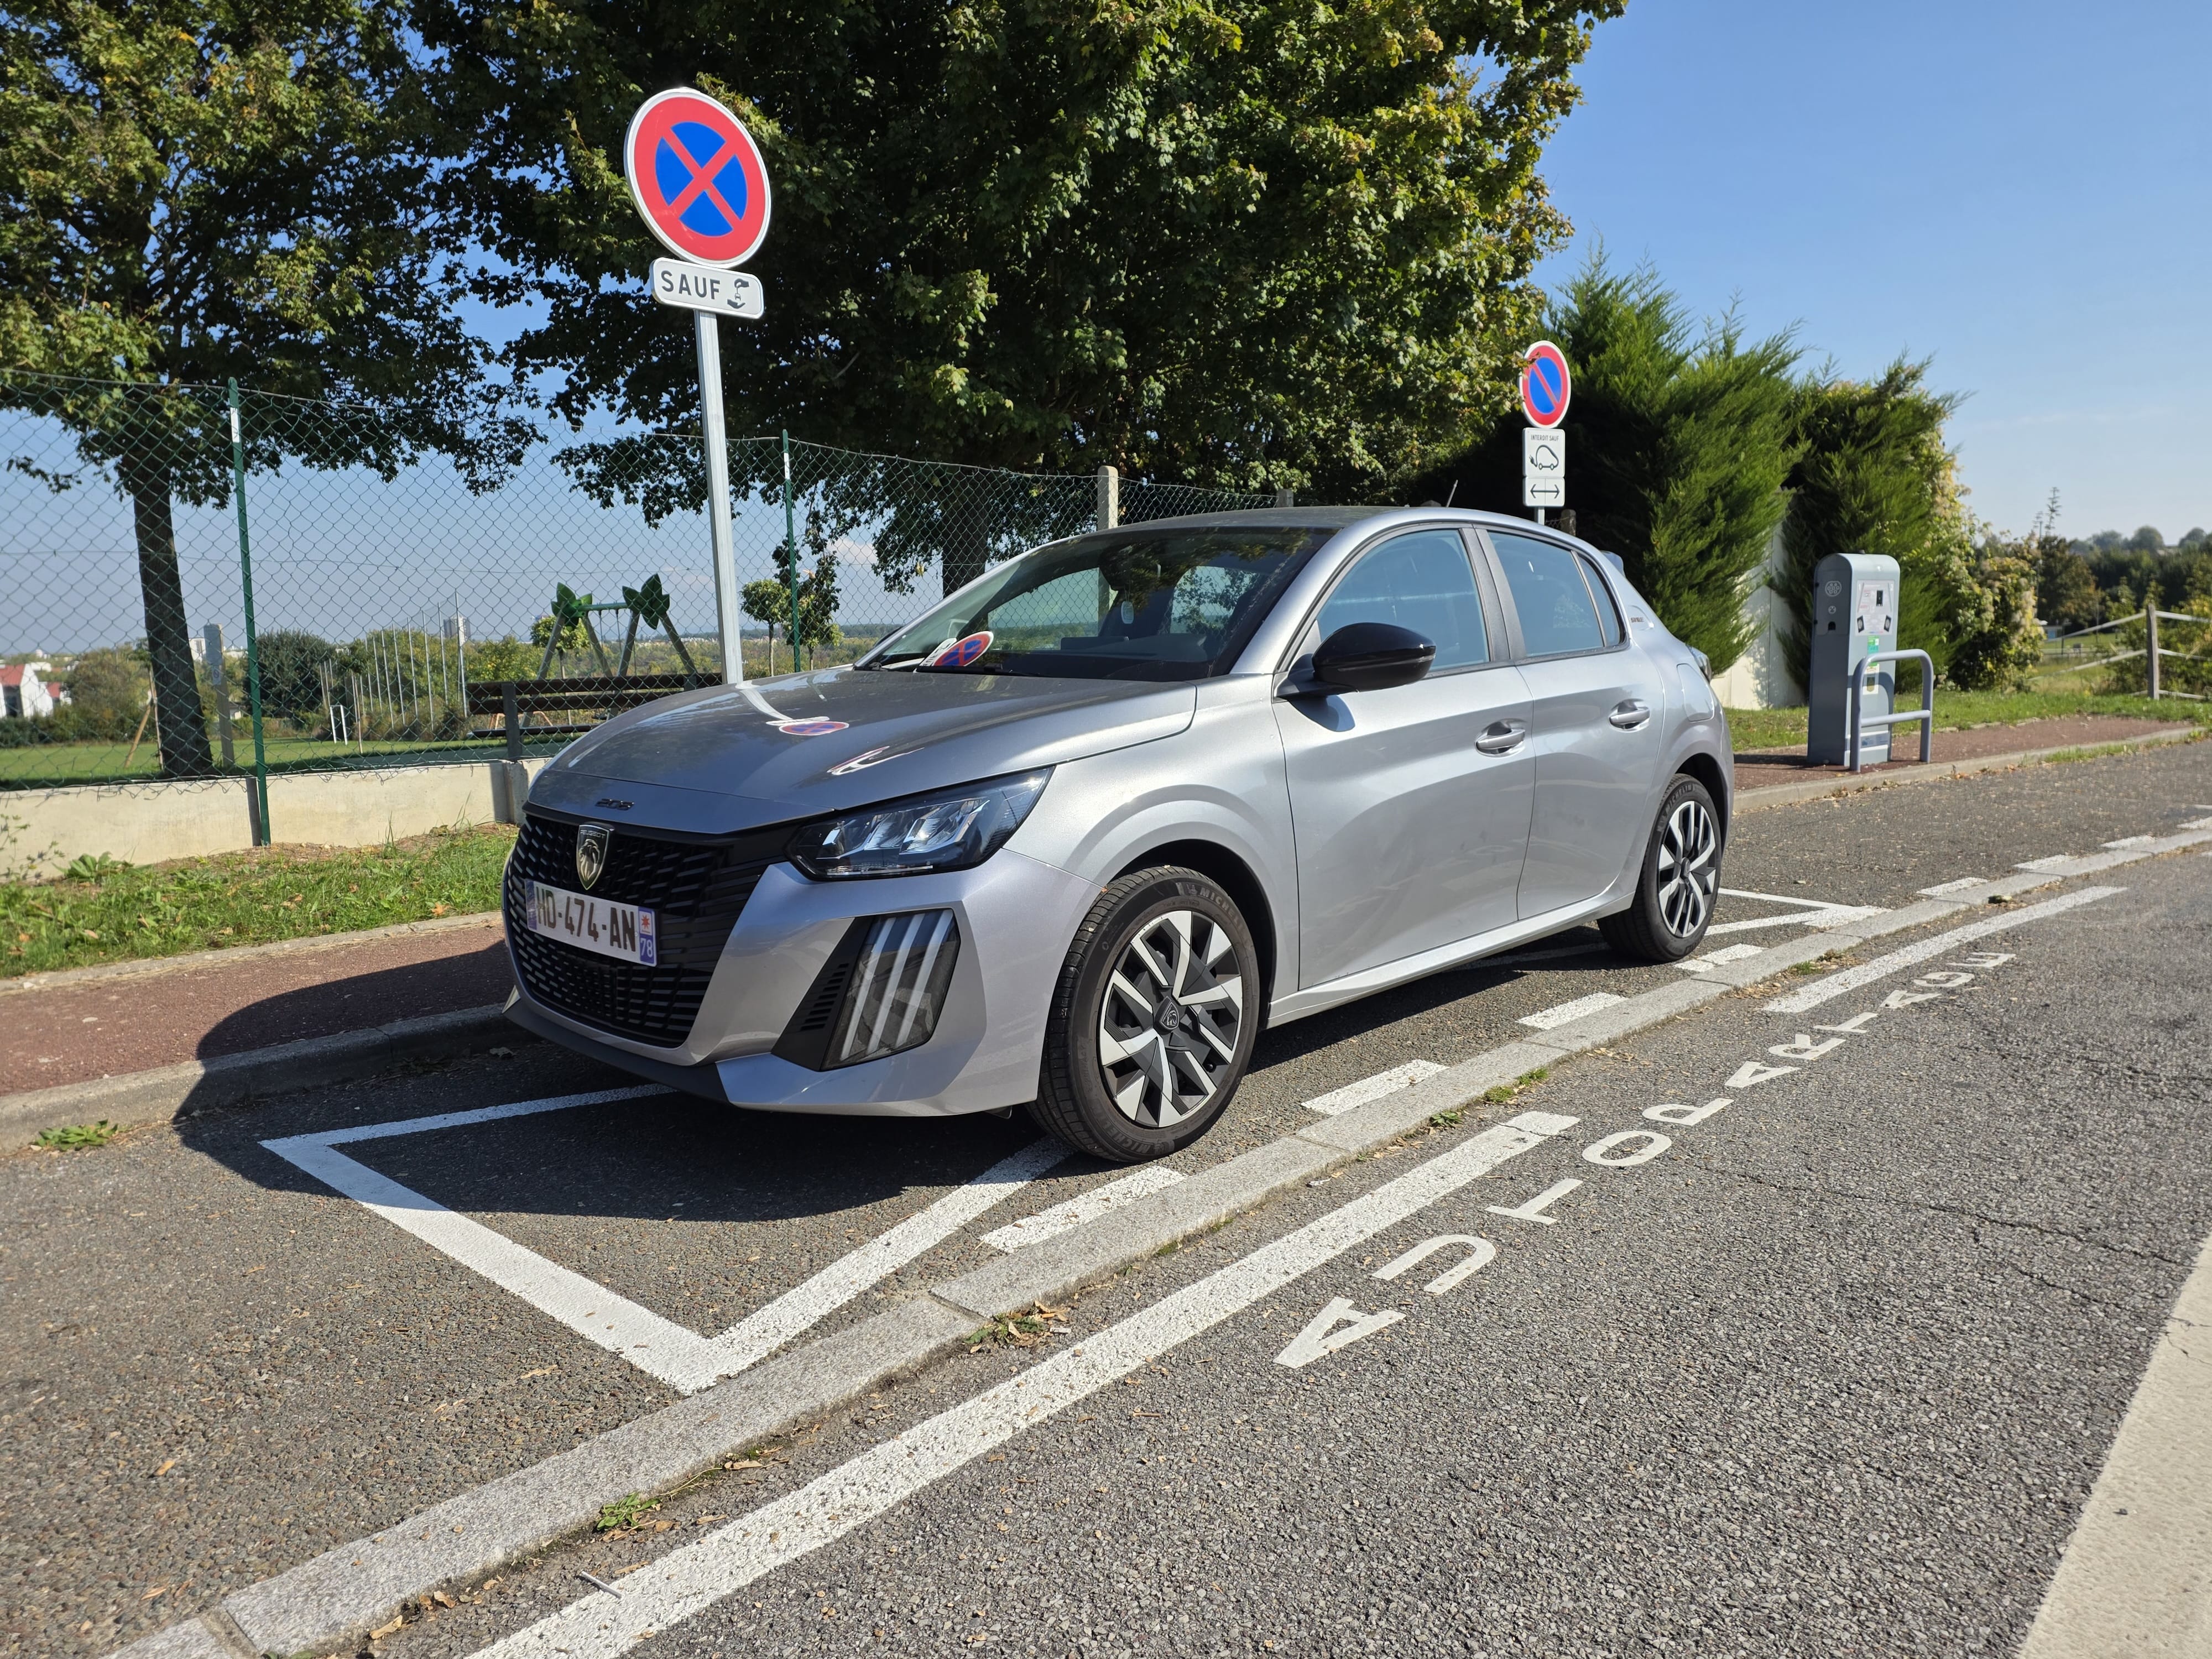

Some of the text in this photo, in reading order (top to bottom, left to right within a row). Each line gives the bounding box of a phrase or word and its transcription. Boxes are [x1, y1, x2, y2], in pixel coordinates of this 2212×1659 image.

[661, 270, 721, 300] SAUF
[580, 829, 606, 839] PEUGEOT
[536, 886, 636, 952] HD-474-AN
[640, 937, 654, 958] 78
[1273, 951, 2017, 1369] AUTOPARTAGE
